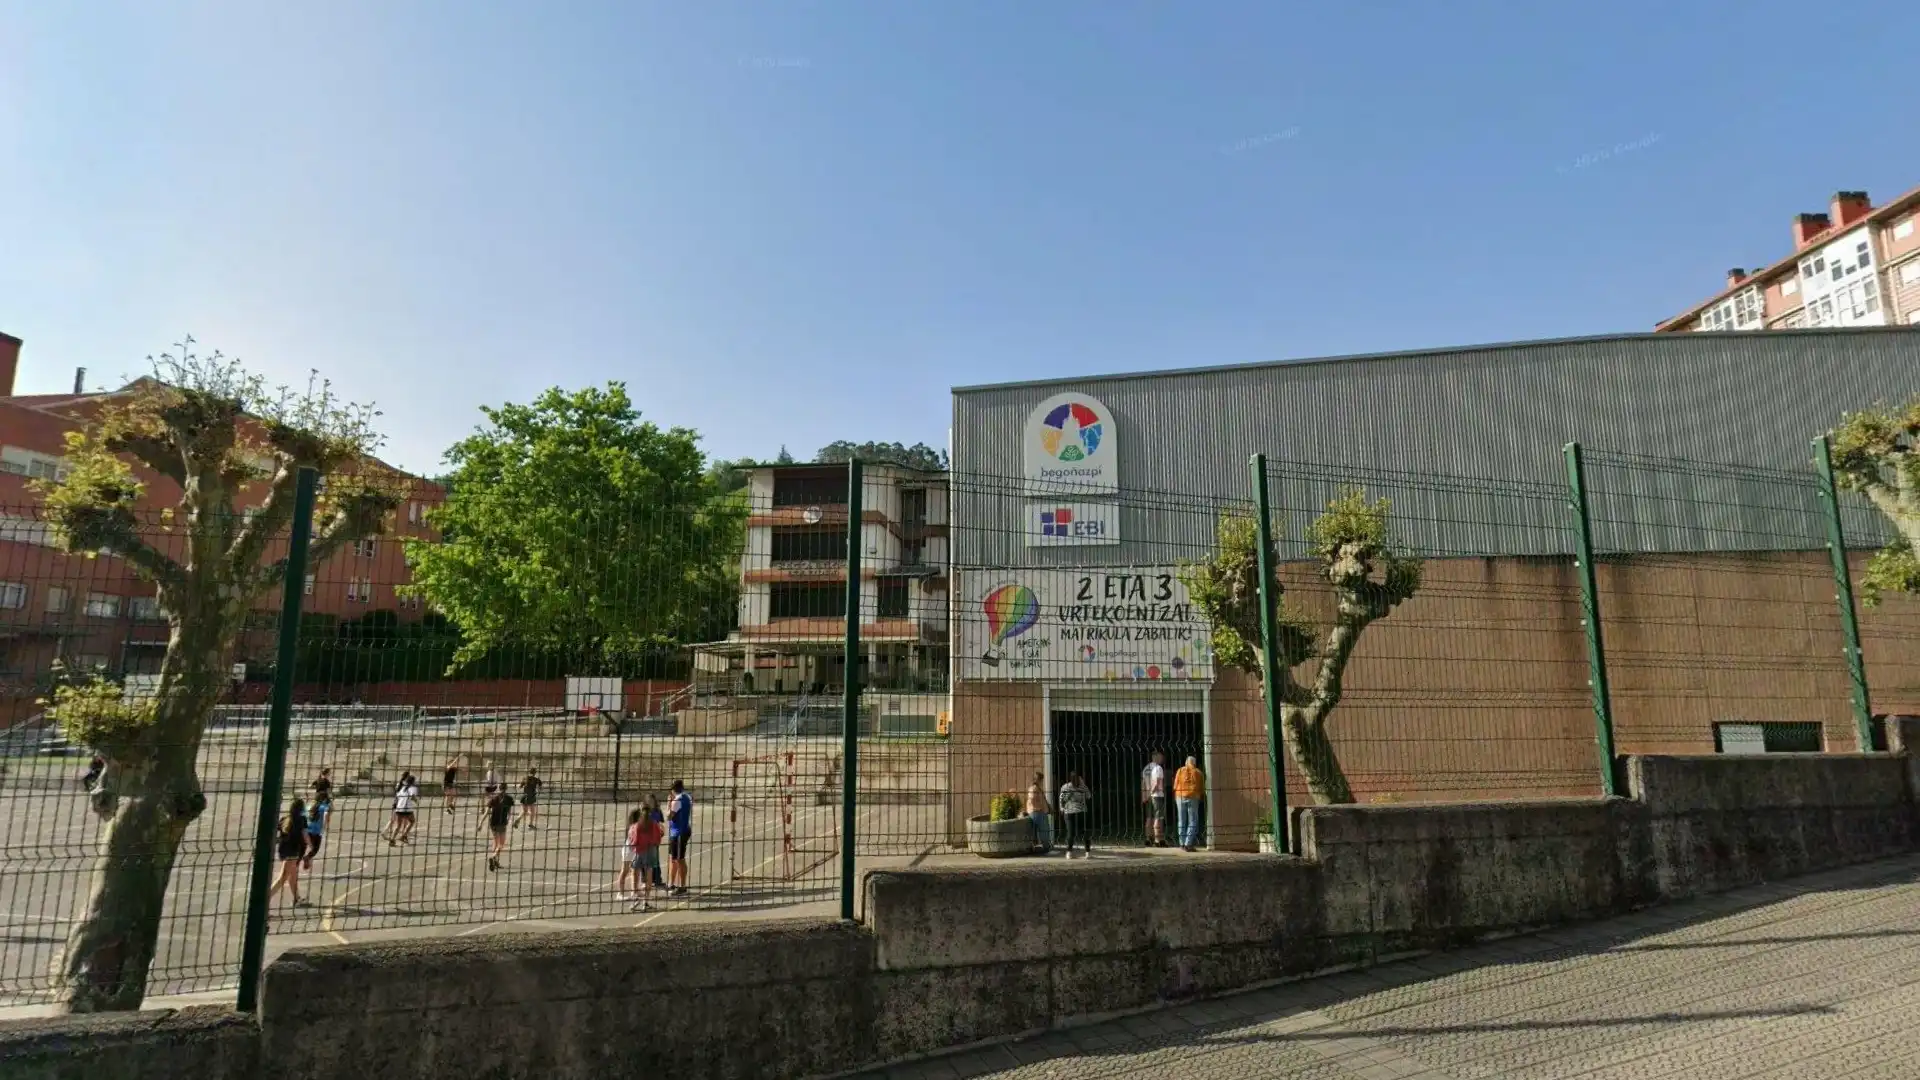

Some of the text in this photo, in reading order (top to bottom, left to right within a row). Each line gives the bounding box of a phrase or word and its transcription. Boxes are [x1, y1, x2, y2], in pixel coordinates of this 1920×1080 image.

[1041, 466, 1102, 479] begoñazpi
[1075, 520, 1104, 535] EBI
[1077, 574, 1172, 601] 2 ETA 3
[1061, 625, 1192, 641] MATRIKULA ZABALIK!
